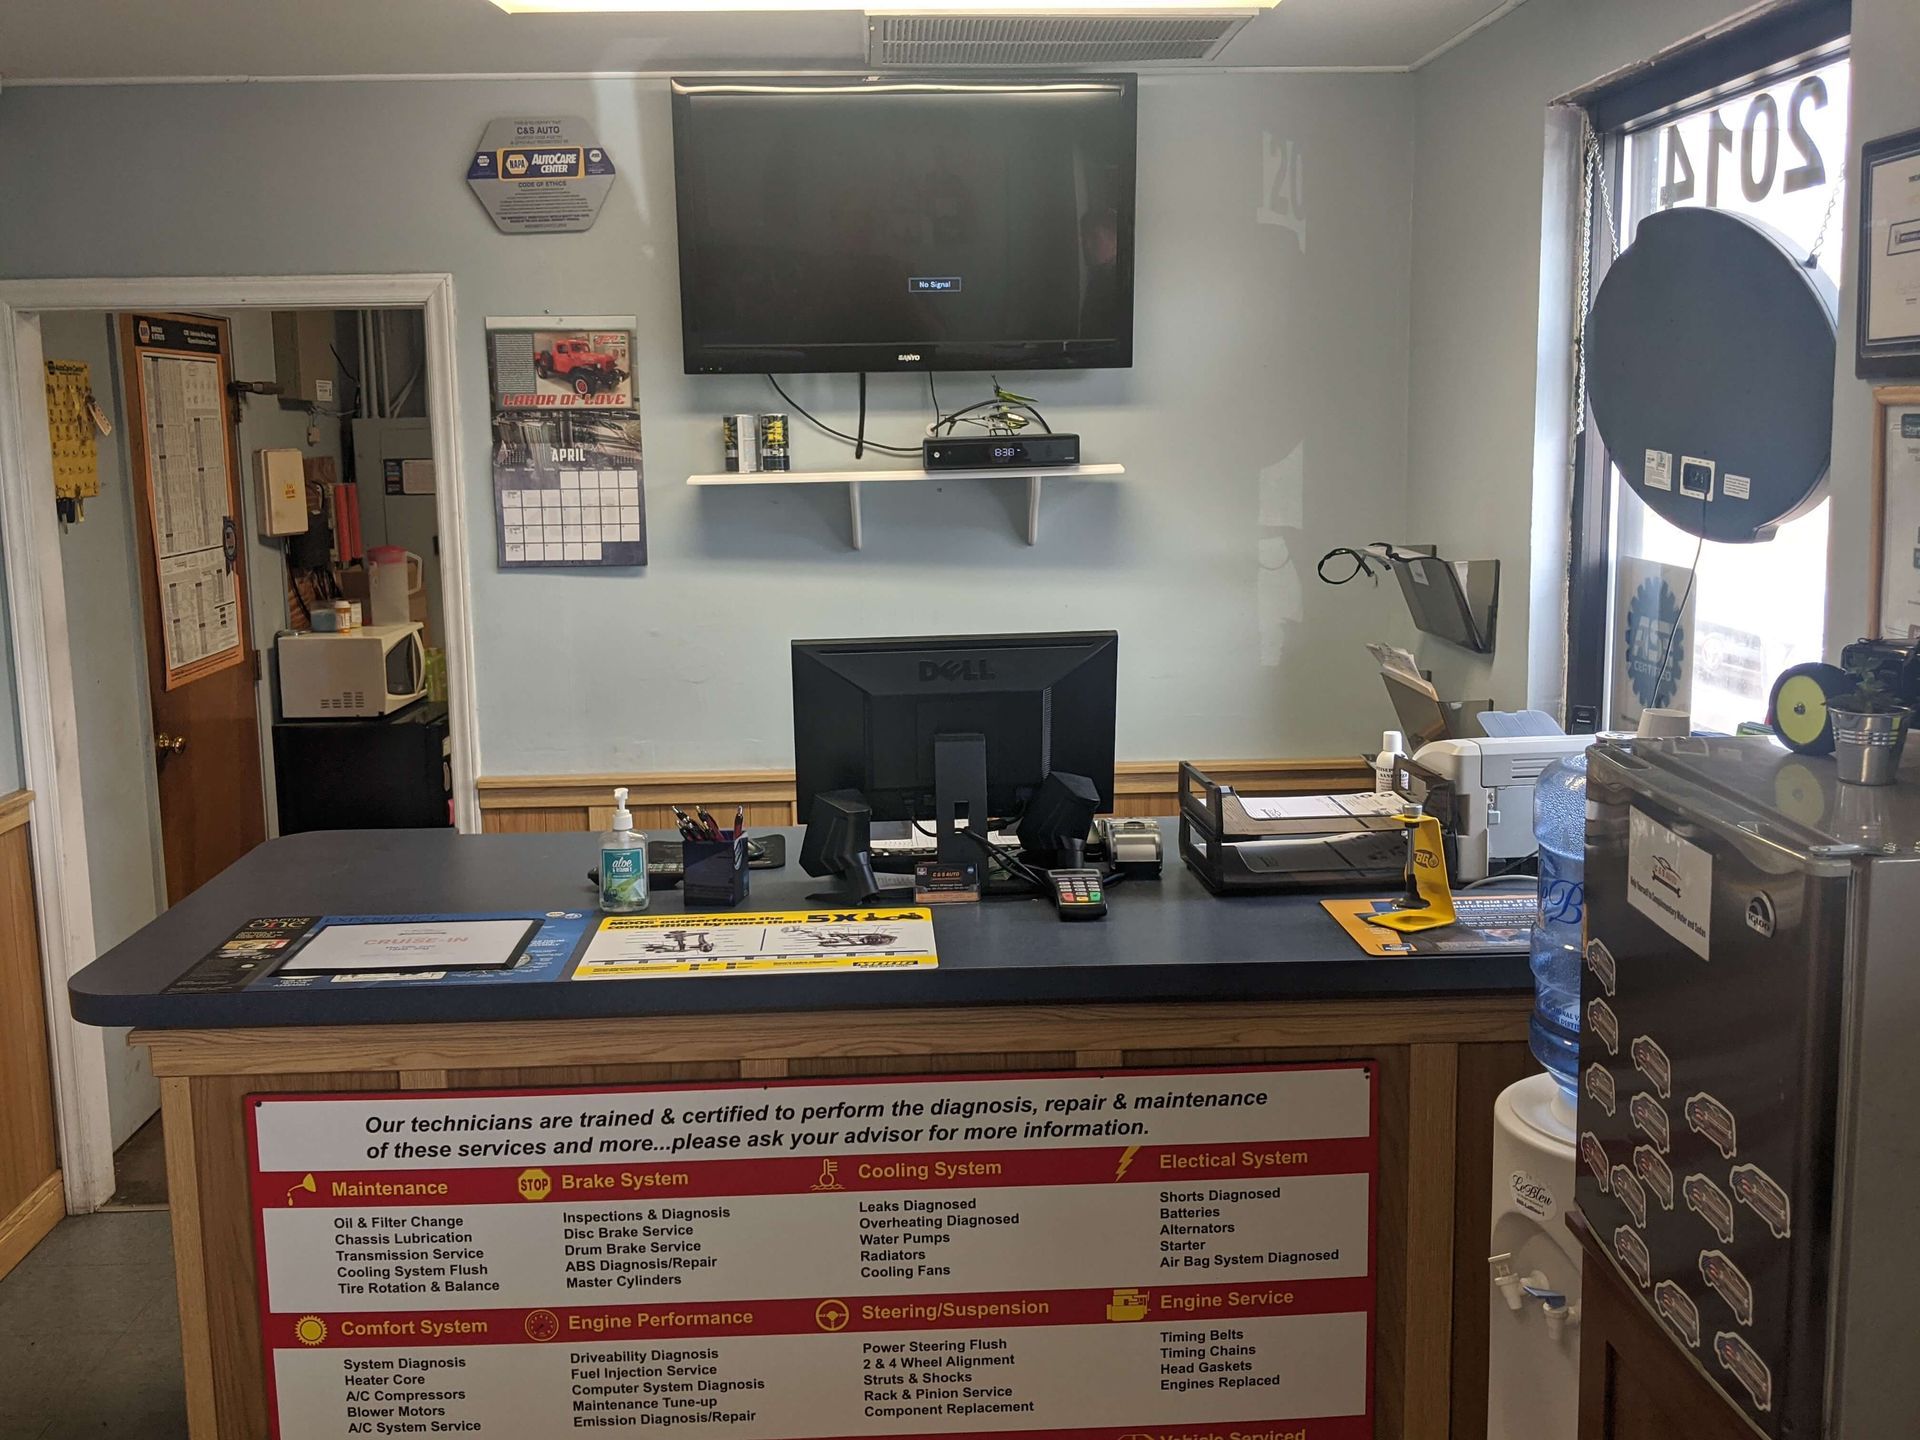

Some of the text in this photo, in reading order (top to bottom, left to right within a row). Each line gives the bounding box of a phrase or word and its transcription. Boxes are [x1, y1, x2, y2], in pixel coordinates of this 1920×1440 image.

[516, 126, 560, 134] C&S AUTO
[509, 158, 526, 169] NAPA
[540, 164, 568, 174] CENTER
[930, 281, 951, 289] Signal
[504, 394, 626, 406] LABOR OF LOVE
[552, 448, 586, 462] APRIL
[918, 659, 996, 682] DELL
[612, 856, 632, 868] aloe
[1416, 852, 1428, 864] BG
[806, 914, 858, 922] 5X
[364, 937, 468, 945] CRUISE-IN
[366, 1092, 1267, 1134] Our technicians are trained & certified to perform the diagnosis, repair & maintenance
[367, 1142, 388, 1159] of
[394, 1141, 451, 1158] these
[458, 1140, 546, 1156] services
[554, 1137, 592, 1154] and
[748, 1131, 783, 1147] ask
[791, 1131, 838, 1149] your
[845, 1127, 922, 1144] advisor
[929, 1124, 958, 1141] for
[964, 1125, 1017, 1140] more
[1024, 1120, 1148, 1138] information.
[1160, 1152, 1307, 1169] Electical System
[859, 1161, 1001, 1180] Cooling System
[521, 1178, 548, 1191] STOP
[562, 1172, 688, 1190] Brake System
[332, 1181, 448, 1196] Maintenance
[1160, 1188, 1280, 1202] Shorts Diagnosed
[860, 1198, 976, 1212] Leaks Diagnosed
[563, 1207, 730, 1225] Inspections & Diagnosis
[1160, 1207, 1220, 1219] Batteries
[334, 1216, 463, 1229] Oil & Filter Change
[860, 1214, 1019, 1229] Overheating Diagnosed
[564, 1225, 693, 1239] Disc Brake Service
[1160, 1224, 1235, 1235] Alternators
[335, 1233, 472, 1245] Chassis Lubrication
[860, 1233, 950, 1245] Water Pumps
[336, 1249, 484, 1261] Transmission Service
[565, 1242, 701, 1256] Drum Brake Service
[861, 1250, 925, 1261] Radiators
[337, 1264, 488, 1279] Cooling System Flush
[566, 1257, 717, 1273] ABS Diagnosis/Repair
[861, 1265, 950, 1279] Cooling Fans
[338, 1281, 500, 1294] Tire Rotation & Balance
[567, 1274, 681, 1289] Master Cylinders
[1160, 1291, 1294, 1311] Engine Service
[862, 1300, 1049, 1321] Steering/Suspension
[341, 1319, 488, 1337] Comfort System
[569, 1312, 753, 1332] Engine Performance
[1161, 1330, 1243, 1343] Timing Belts
[863, 1339, 1007, 1353] Power Steering Flush
[1161, 1346, 1256, 1359] Timing Chains
[571, 1349, 718, 1364] Driveability Diagnosis
[344, 1357, 466, 1372] System Diagnosis
[1161, 1361, 1252, 1374] Head Gaskets
[345, 1374, 425, 1385] Heater Core
[572, 1365, 717, 1380] Fuel Injection Service
[864, 1372, 972, 1385] Struts & Shocks
[572, 1379, 765, 1396] Computer System Diagnosis
[1161, 1375, 1280, 1391] Engines Replaced
[346, 1390, 466, 1403] A/C Compressors
[573, 1397, 717, 1412] Maintenance Tune-up
[865, 1402, 1034, 1418] Component Replacement
[348, 1406, 445, 1418] Blower Motors
[574, 1411, 756, 1428] Emission Diagnosis/Repair
[348, 1421, 481, 1435] A/C System Service
